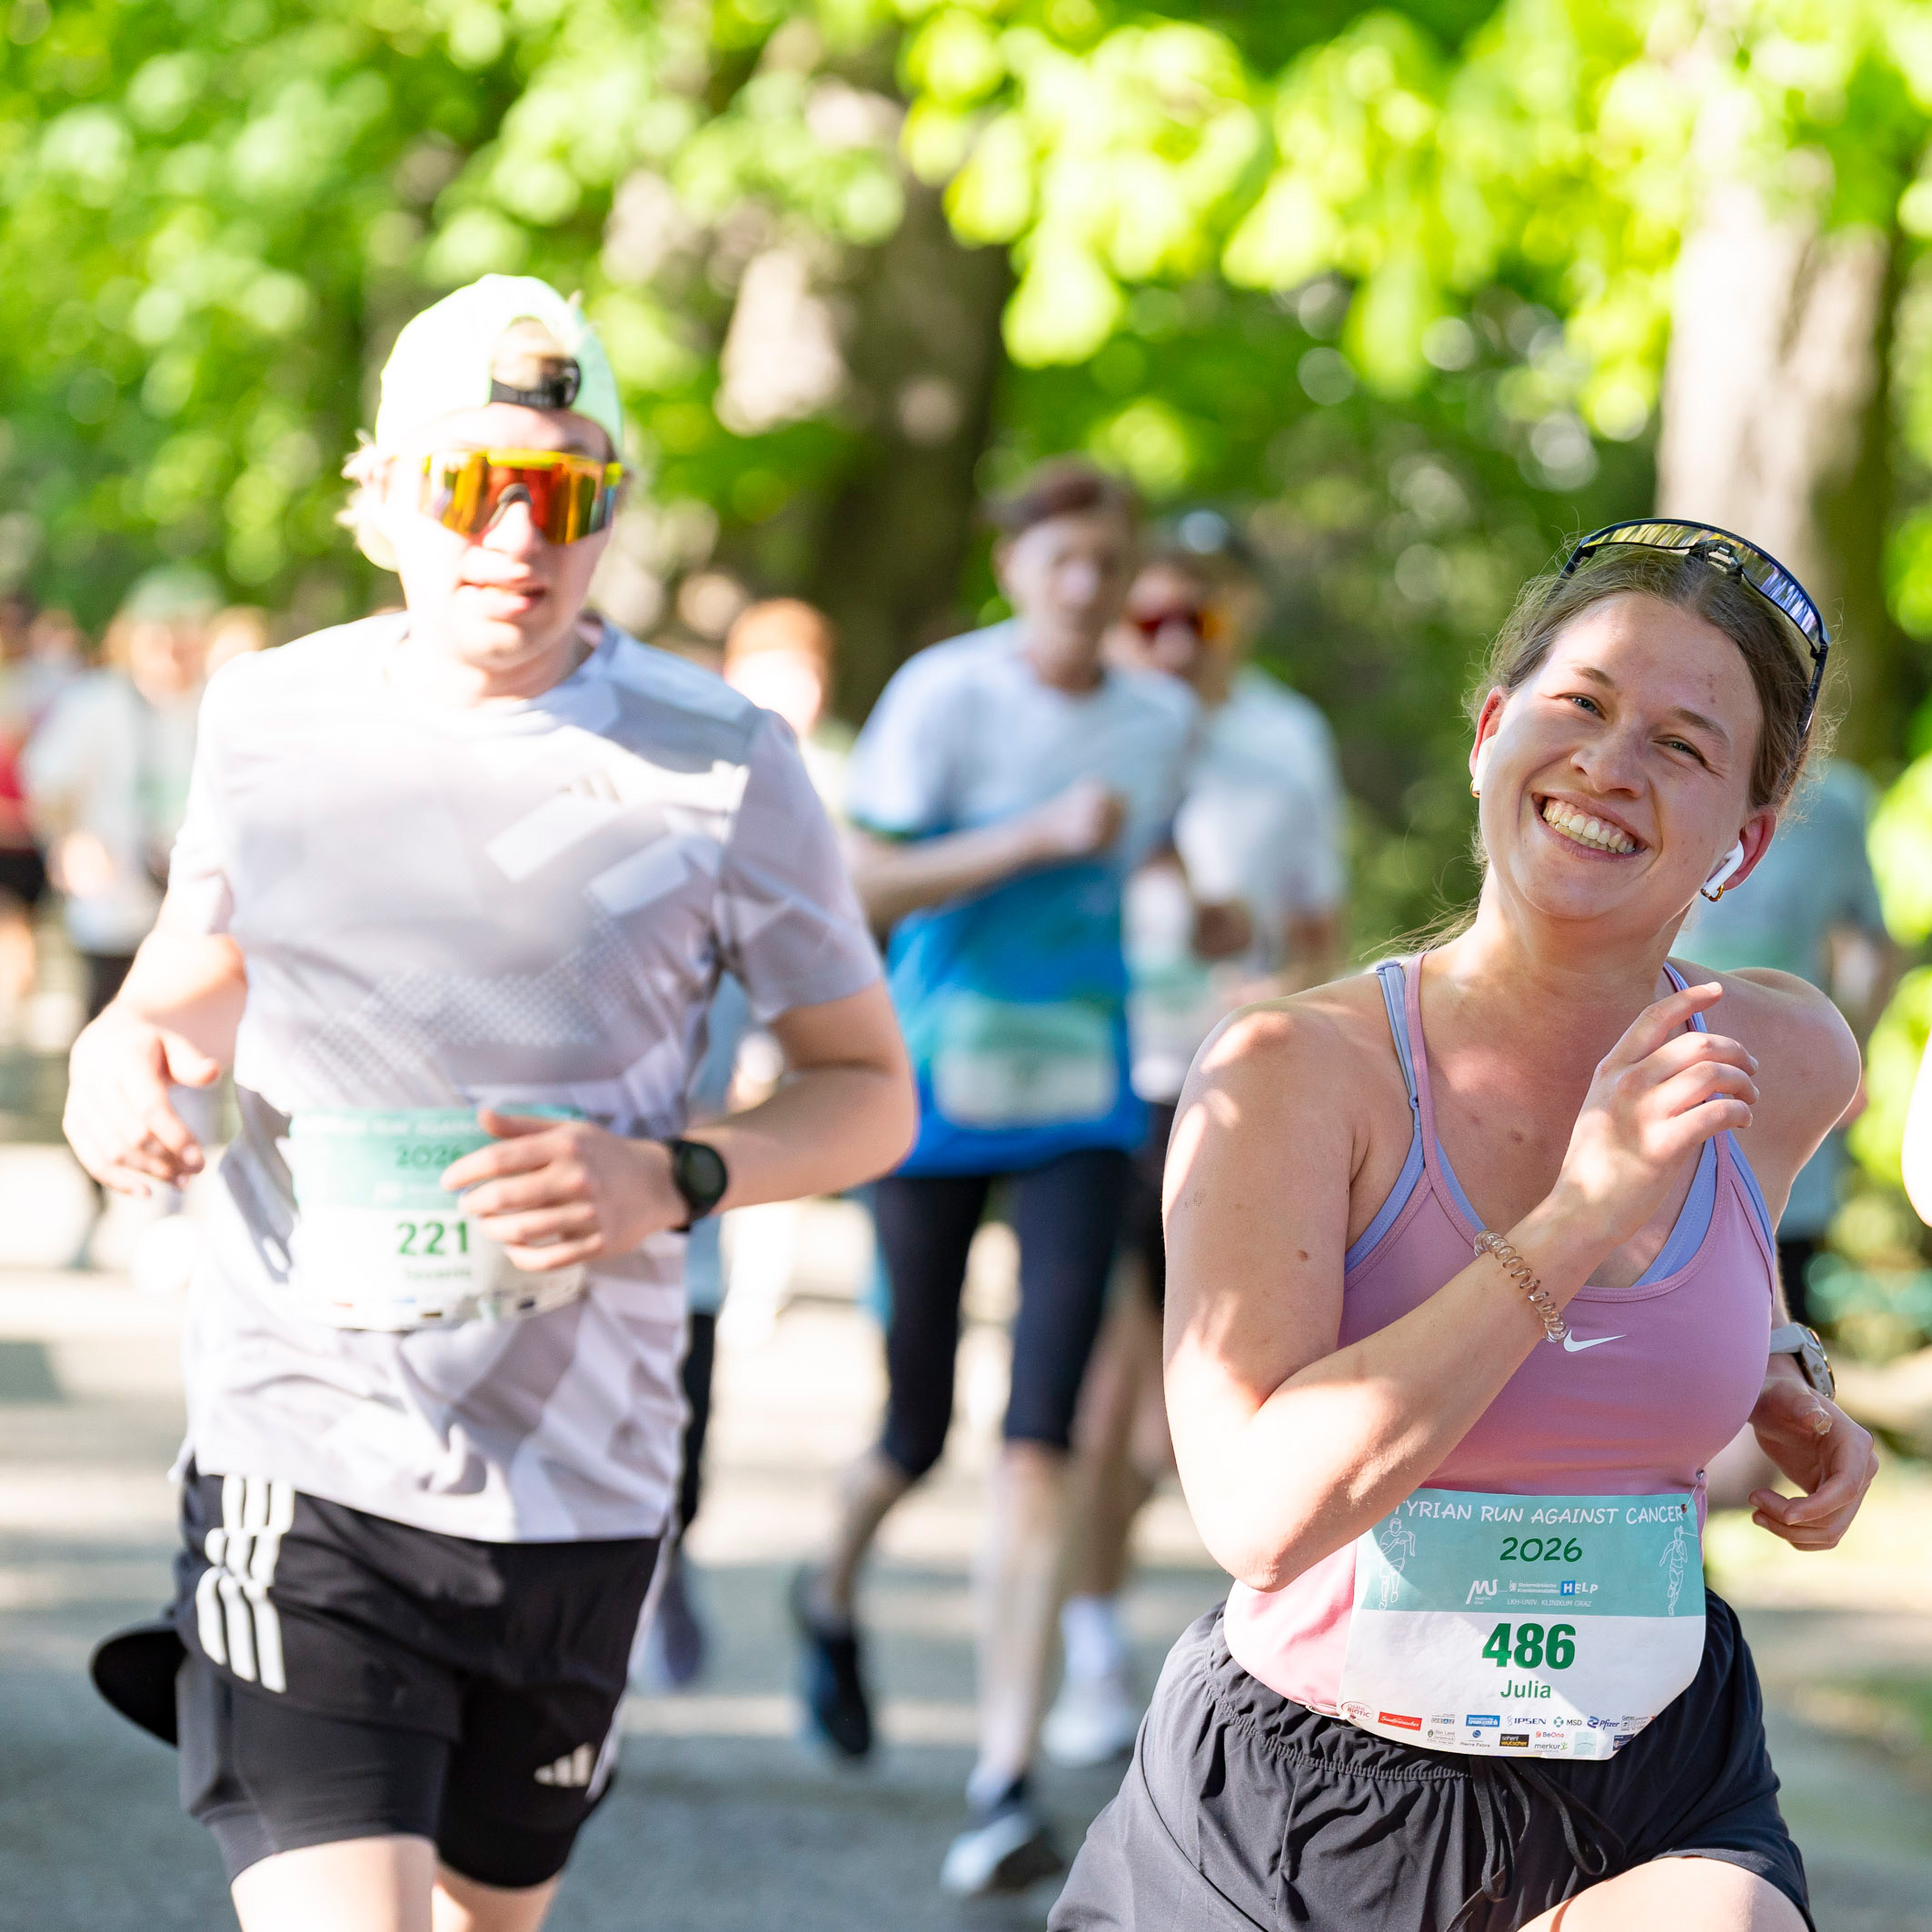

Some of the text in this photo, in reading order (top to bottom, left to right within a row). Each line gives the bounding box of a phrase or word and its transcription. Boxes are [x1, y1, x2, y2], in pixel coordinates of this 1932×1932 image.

[397, 1220, 469, 1256] 221
[1395, 1499, 1684, 1525] TYRIAN RUN AGAINST CANCER
[1499, 1537, 1583, 1563] 2026
[1563, 1582, 1599, 1594] HELP
[1574, 1599, 1592, 1608] GRAZ
[1481, 1623, 1577, 1669] 486
[1500, 1679, 1551, 1698] Julia
[1598, 1719, 1620, 1730] Pfizer
[1534, 1742, 1561, 1750] merkur
